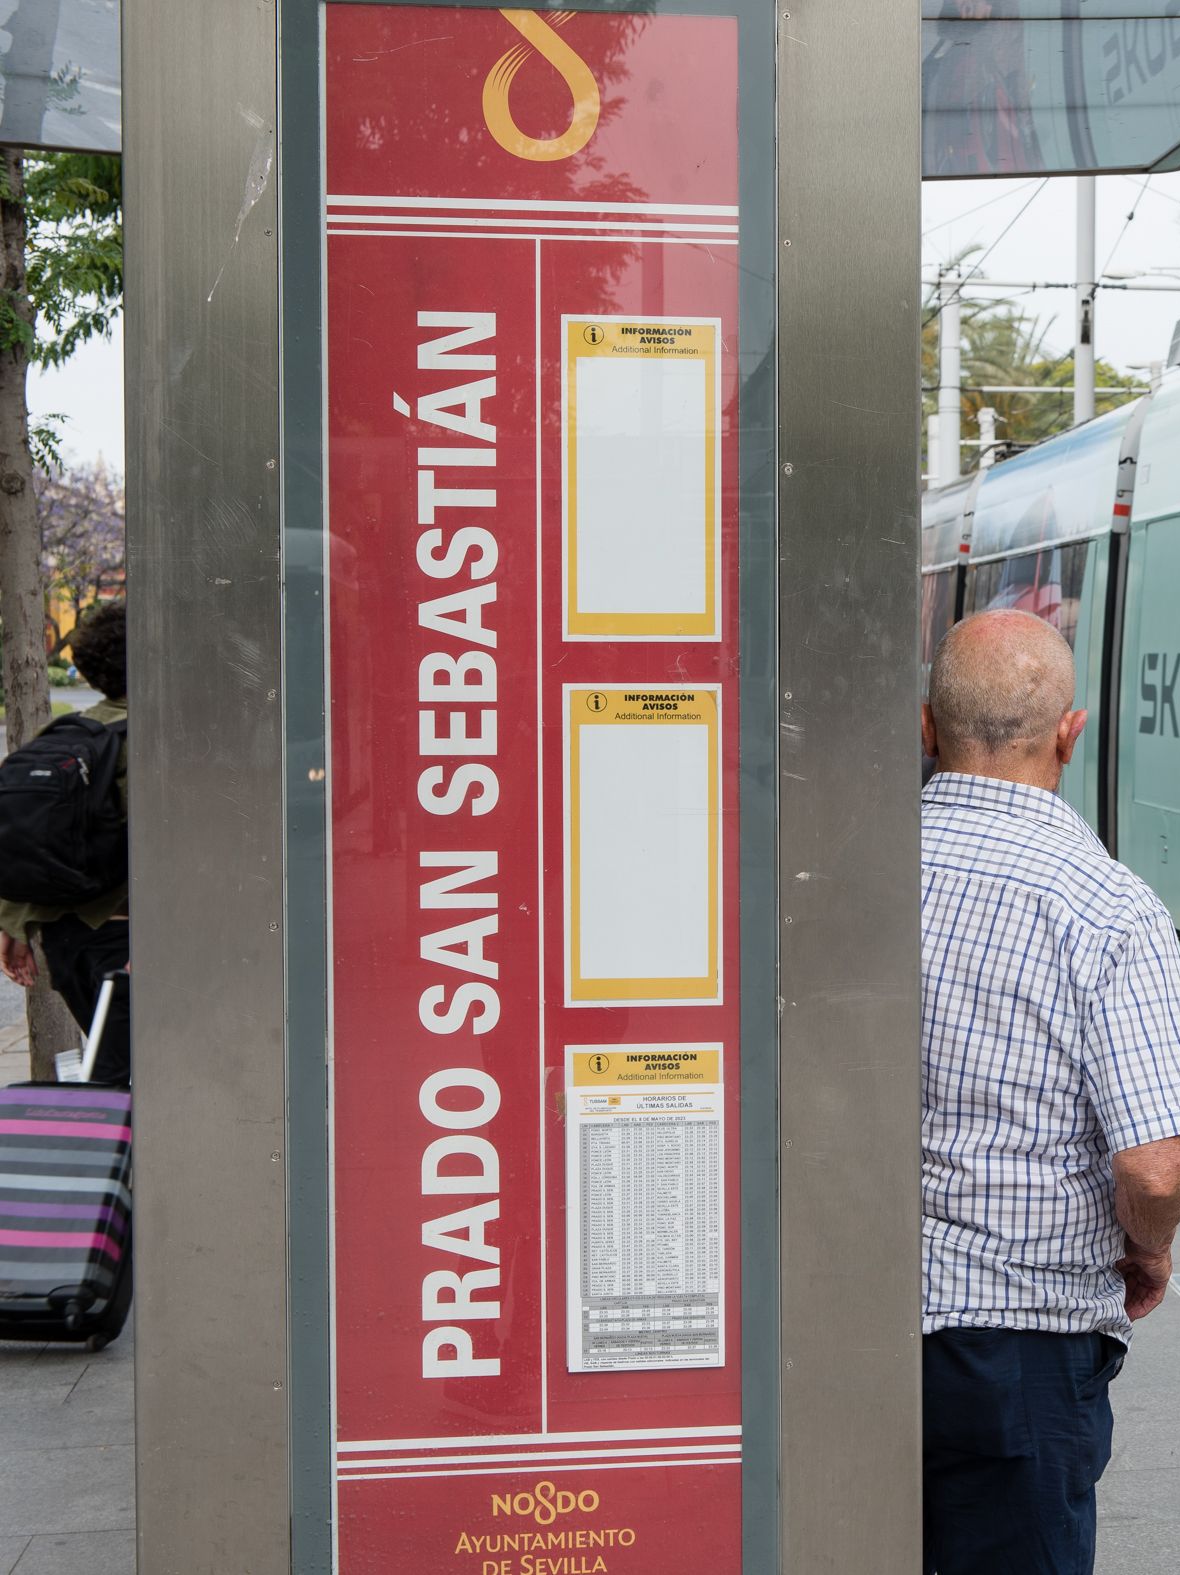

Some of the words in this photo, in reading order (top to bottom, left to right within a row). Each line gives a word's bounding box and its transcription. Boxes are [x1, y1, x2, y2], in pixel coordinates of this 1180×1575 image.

[621, 327, 692, 336] INFORMACIÓN
[639, 336, 676, 345] AVISOS
[611, 345, 652, 354] Additional
[653, 346, 699, 355] Information
[393, 310, 500, 817] SEBASTIÁN
[624, 692, 695, 702] INFORMACIÓN
[642, 702, 679, 711] AVISOS
[614, 712, 655, 720] Additional
[656, 712, 702, 720] Information
[418, 850, 501, 1035] SAN
[626, 1052, 698, 1062] INFORMACIÓN
[644, 1062, 681, 1071] AVISOS
[616, 1073, 657, 1081] Additional
[659, 1072, 705, 1080] Information
[418, 1068, 501, 1379] PRADO
[482, 1560, 512, 1575] DE
